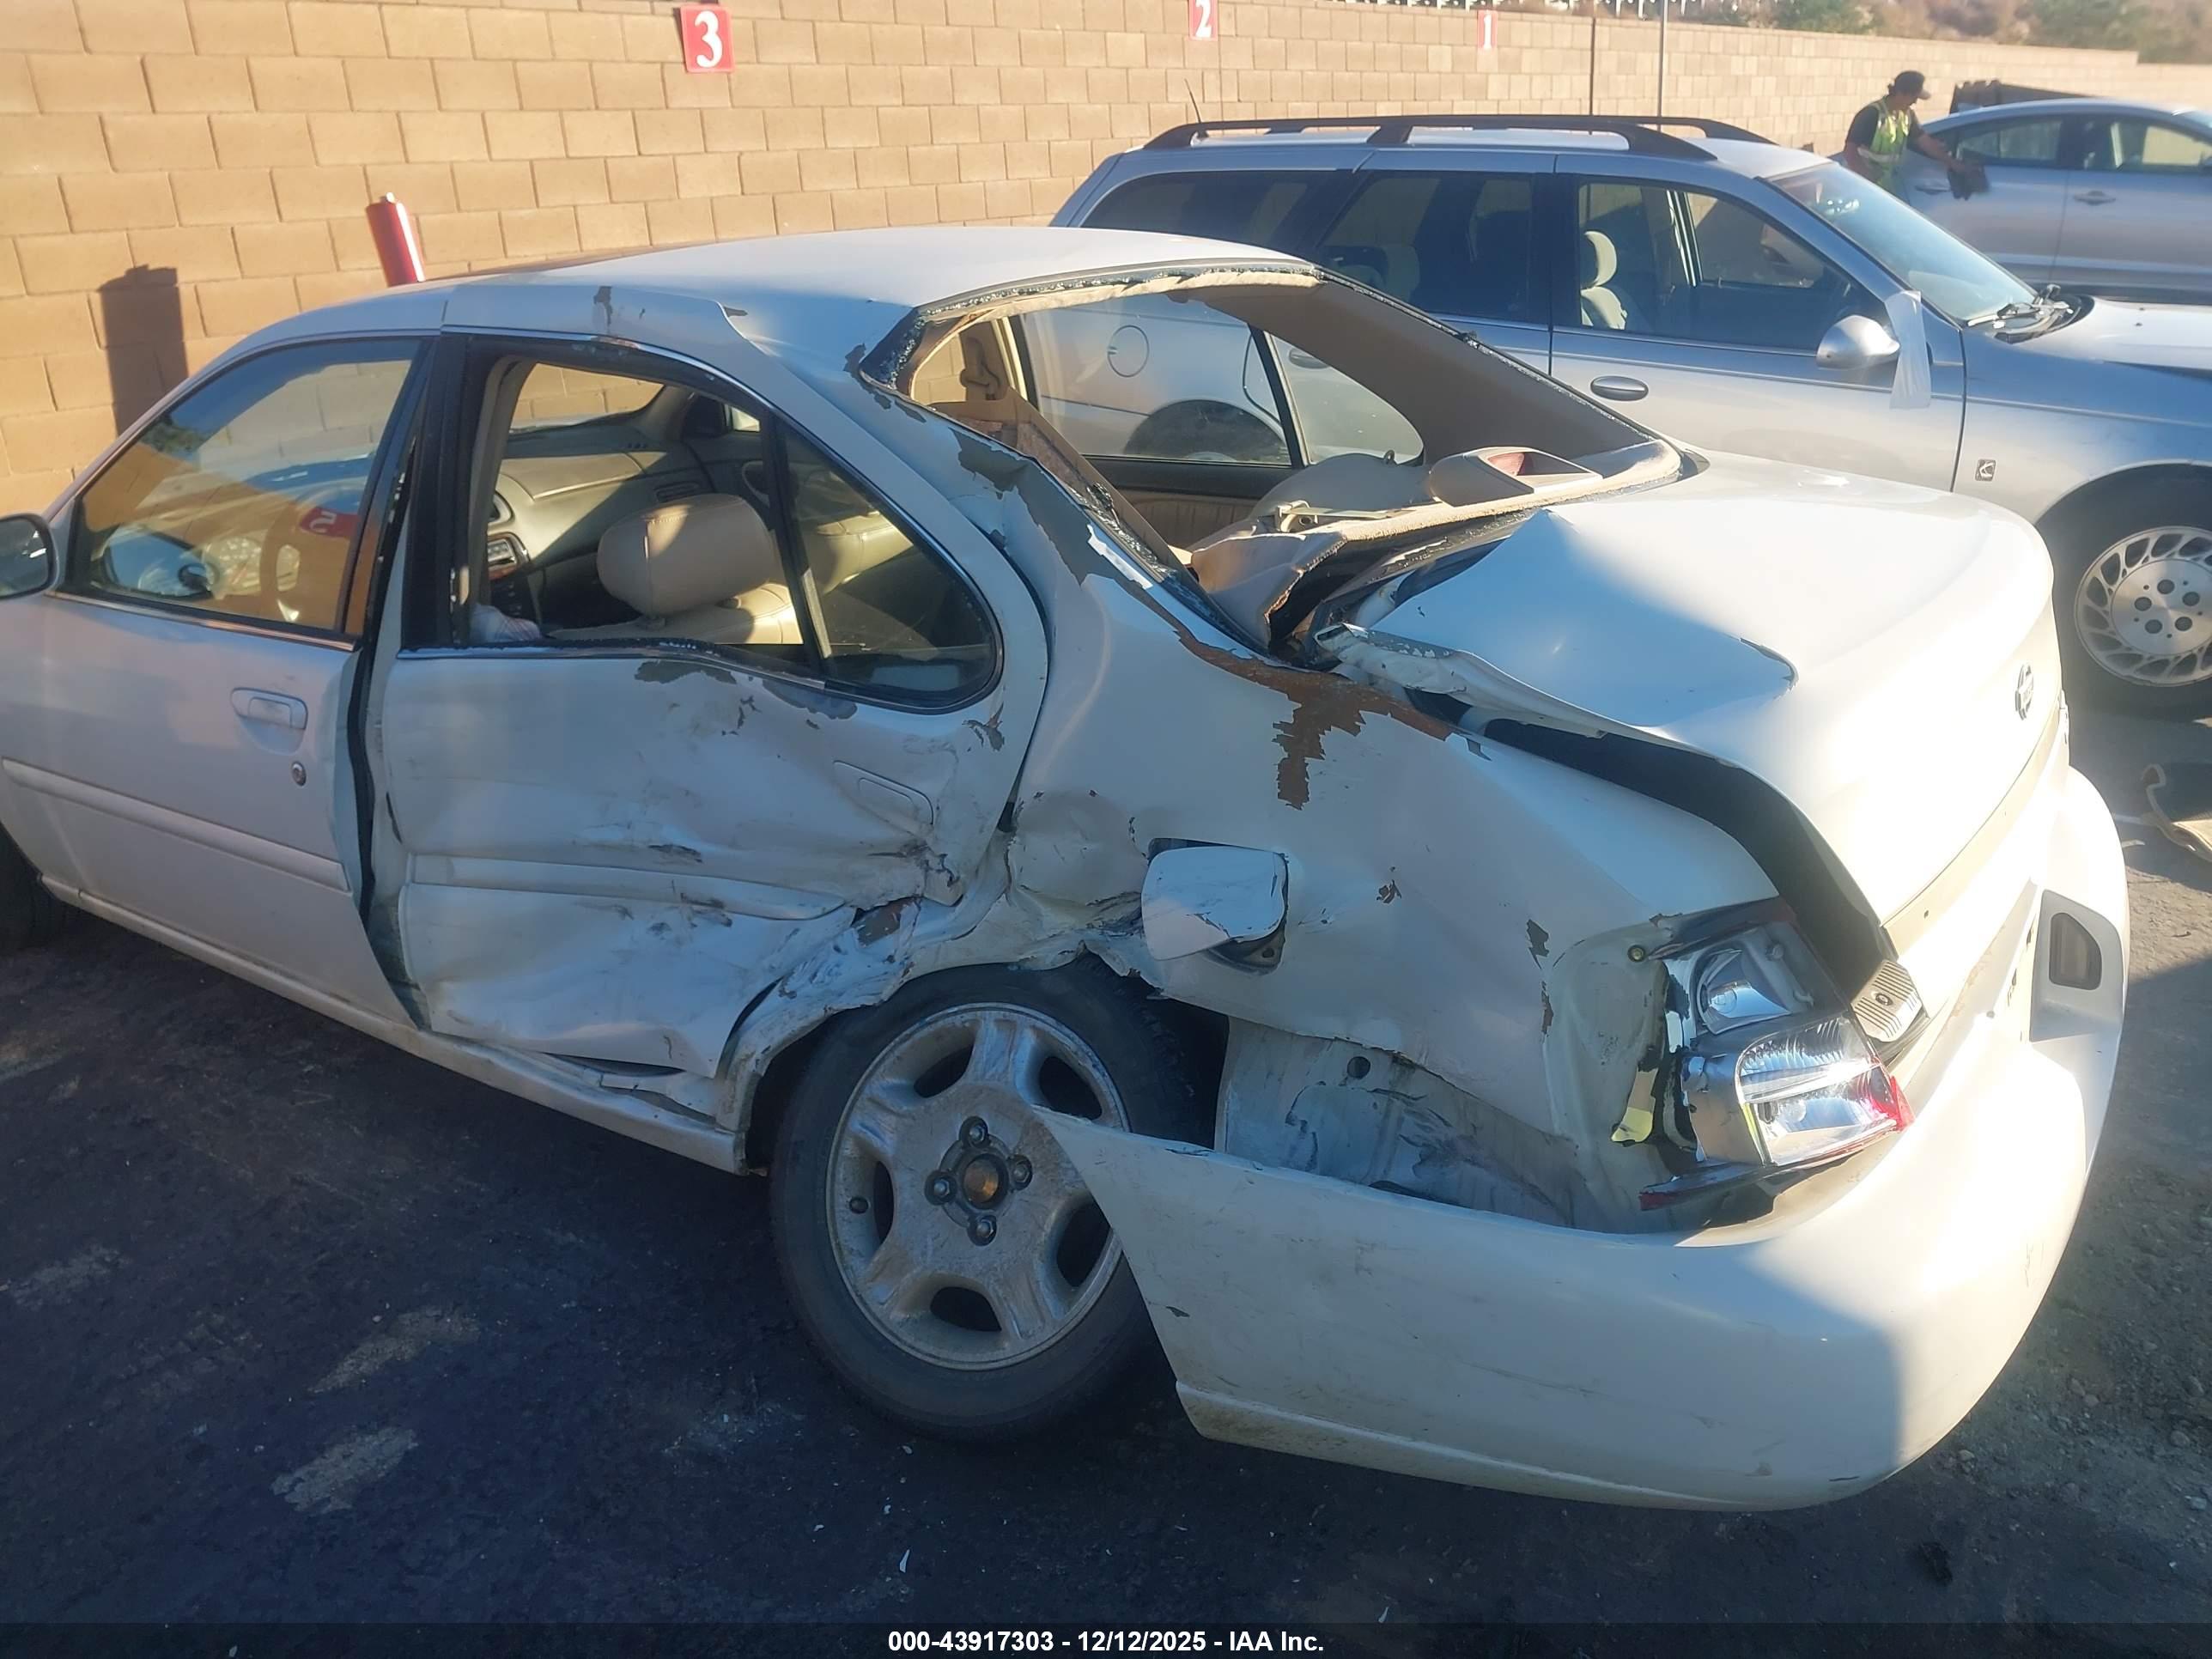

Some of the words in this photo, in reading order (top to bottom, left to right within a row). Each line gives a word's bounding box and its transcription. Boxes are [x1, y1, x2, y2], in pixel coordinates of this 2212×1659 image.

[694, 9, 723, 69] 3
[1194, 0, 1212, 39] 2
[1483, 13, 1492, 50] 1
